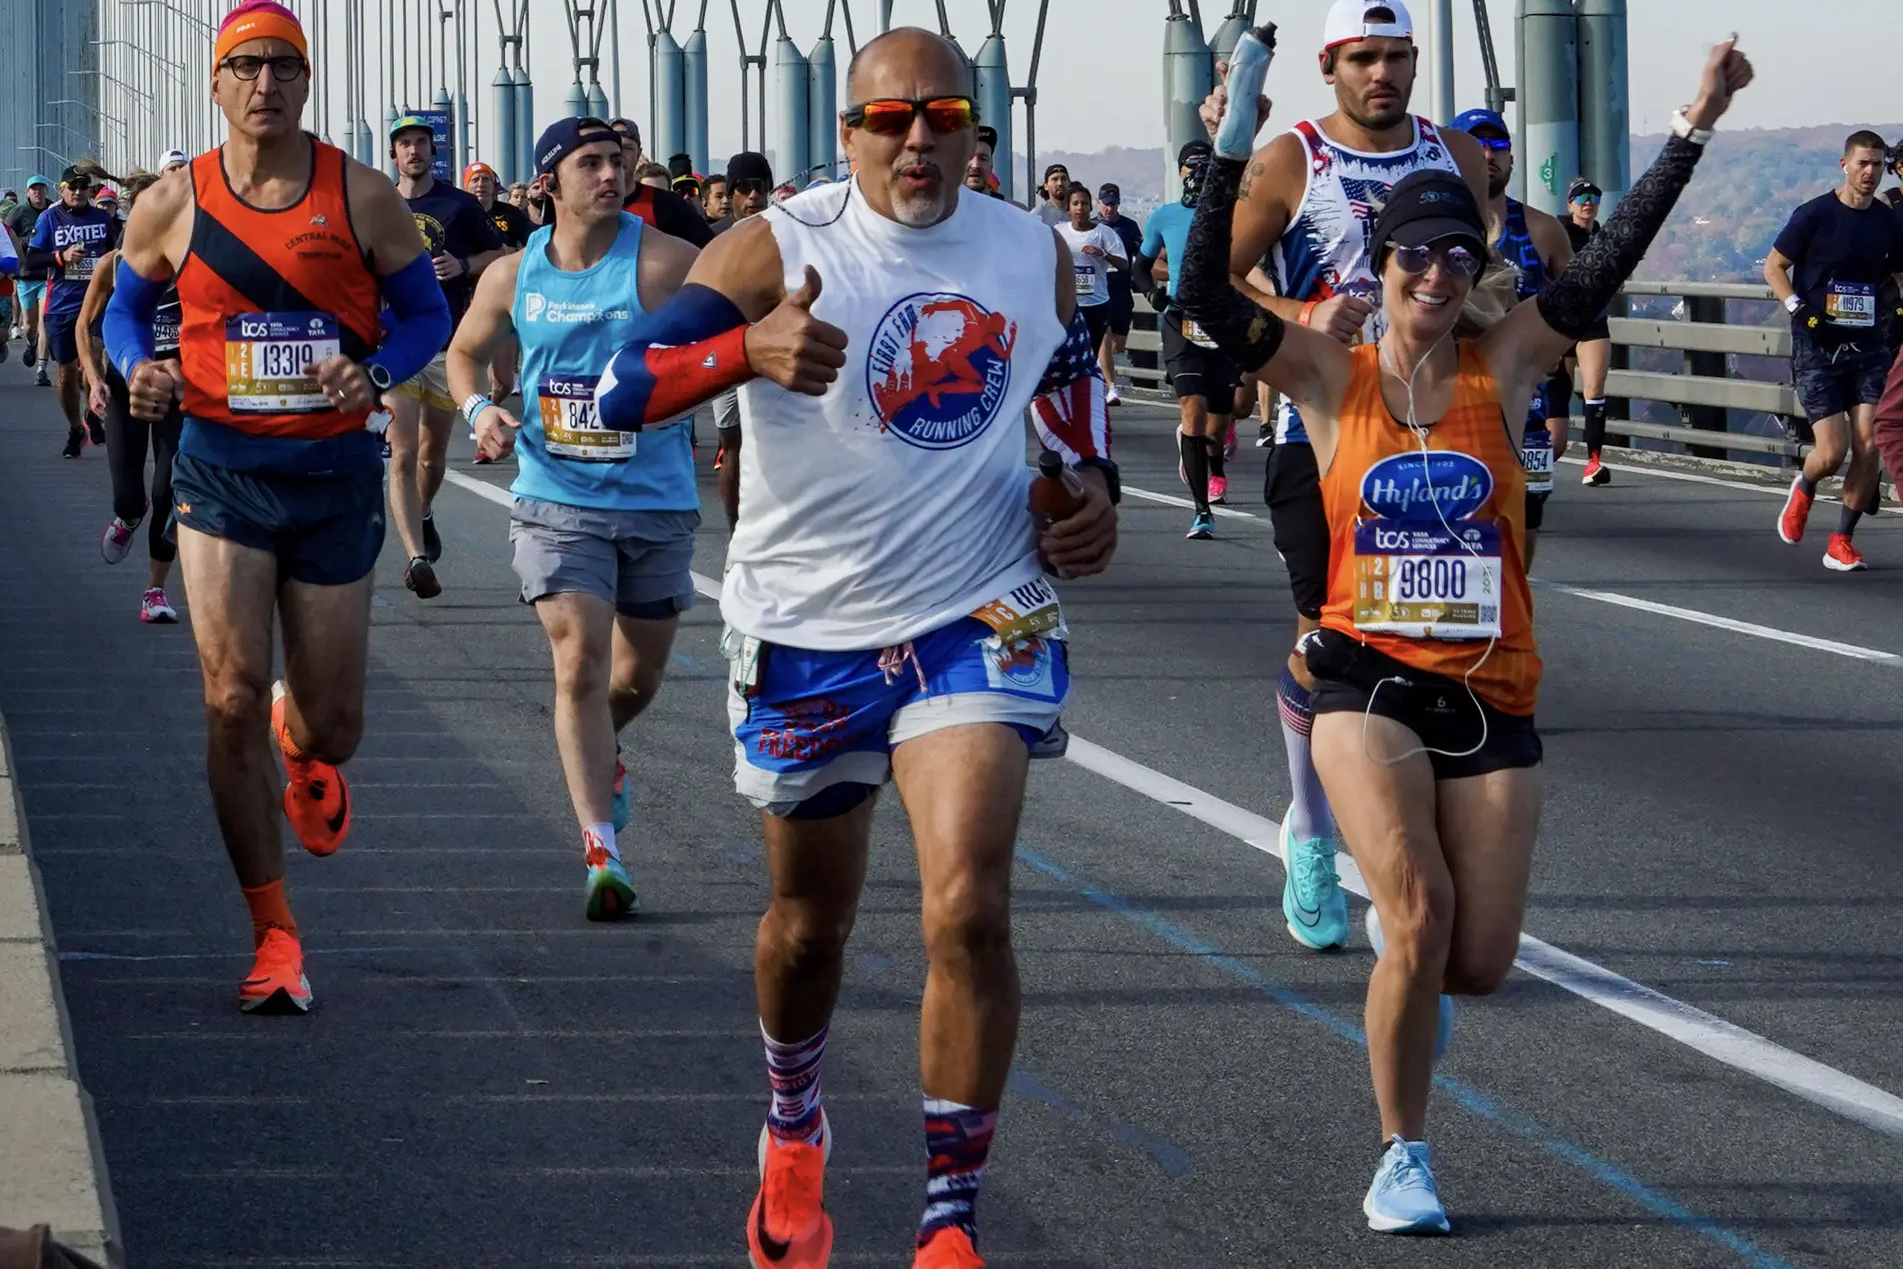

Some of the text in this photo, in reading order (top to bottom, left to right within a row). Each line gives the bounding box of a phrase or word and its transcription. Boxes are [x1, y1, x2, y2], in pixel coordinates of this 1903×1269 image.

[1843, 296, 1864, 311] 11979
[241, 320, 268, 337] tcs
[263, 343, 313, 376] 13319
[872, 330, 901, 375] FIRST
[549, 379, 572, 396] tcs
[979, 358, 1004, 412] CREW
[569, 402, 605, 431] 842
[908, 406, 981, 440] RUNNING
[1372, 474, 1483, 512] Hyland's
[1375, 527, 1410, 550] tcs
[1459, 542, 1483, 551] TATA
[1373, 557, 1383, 576] 2
[1400, 559, 1466, 599] 9800
